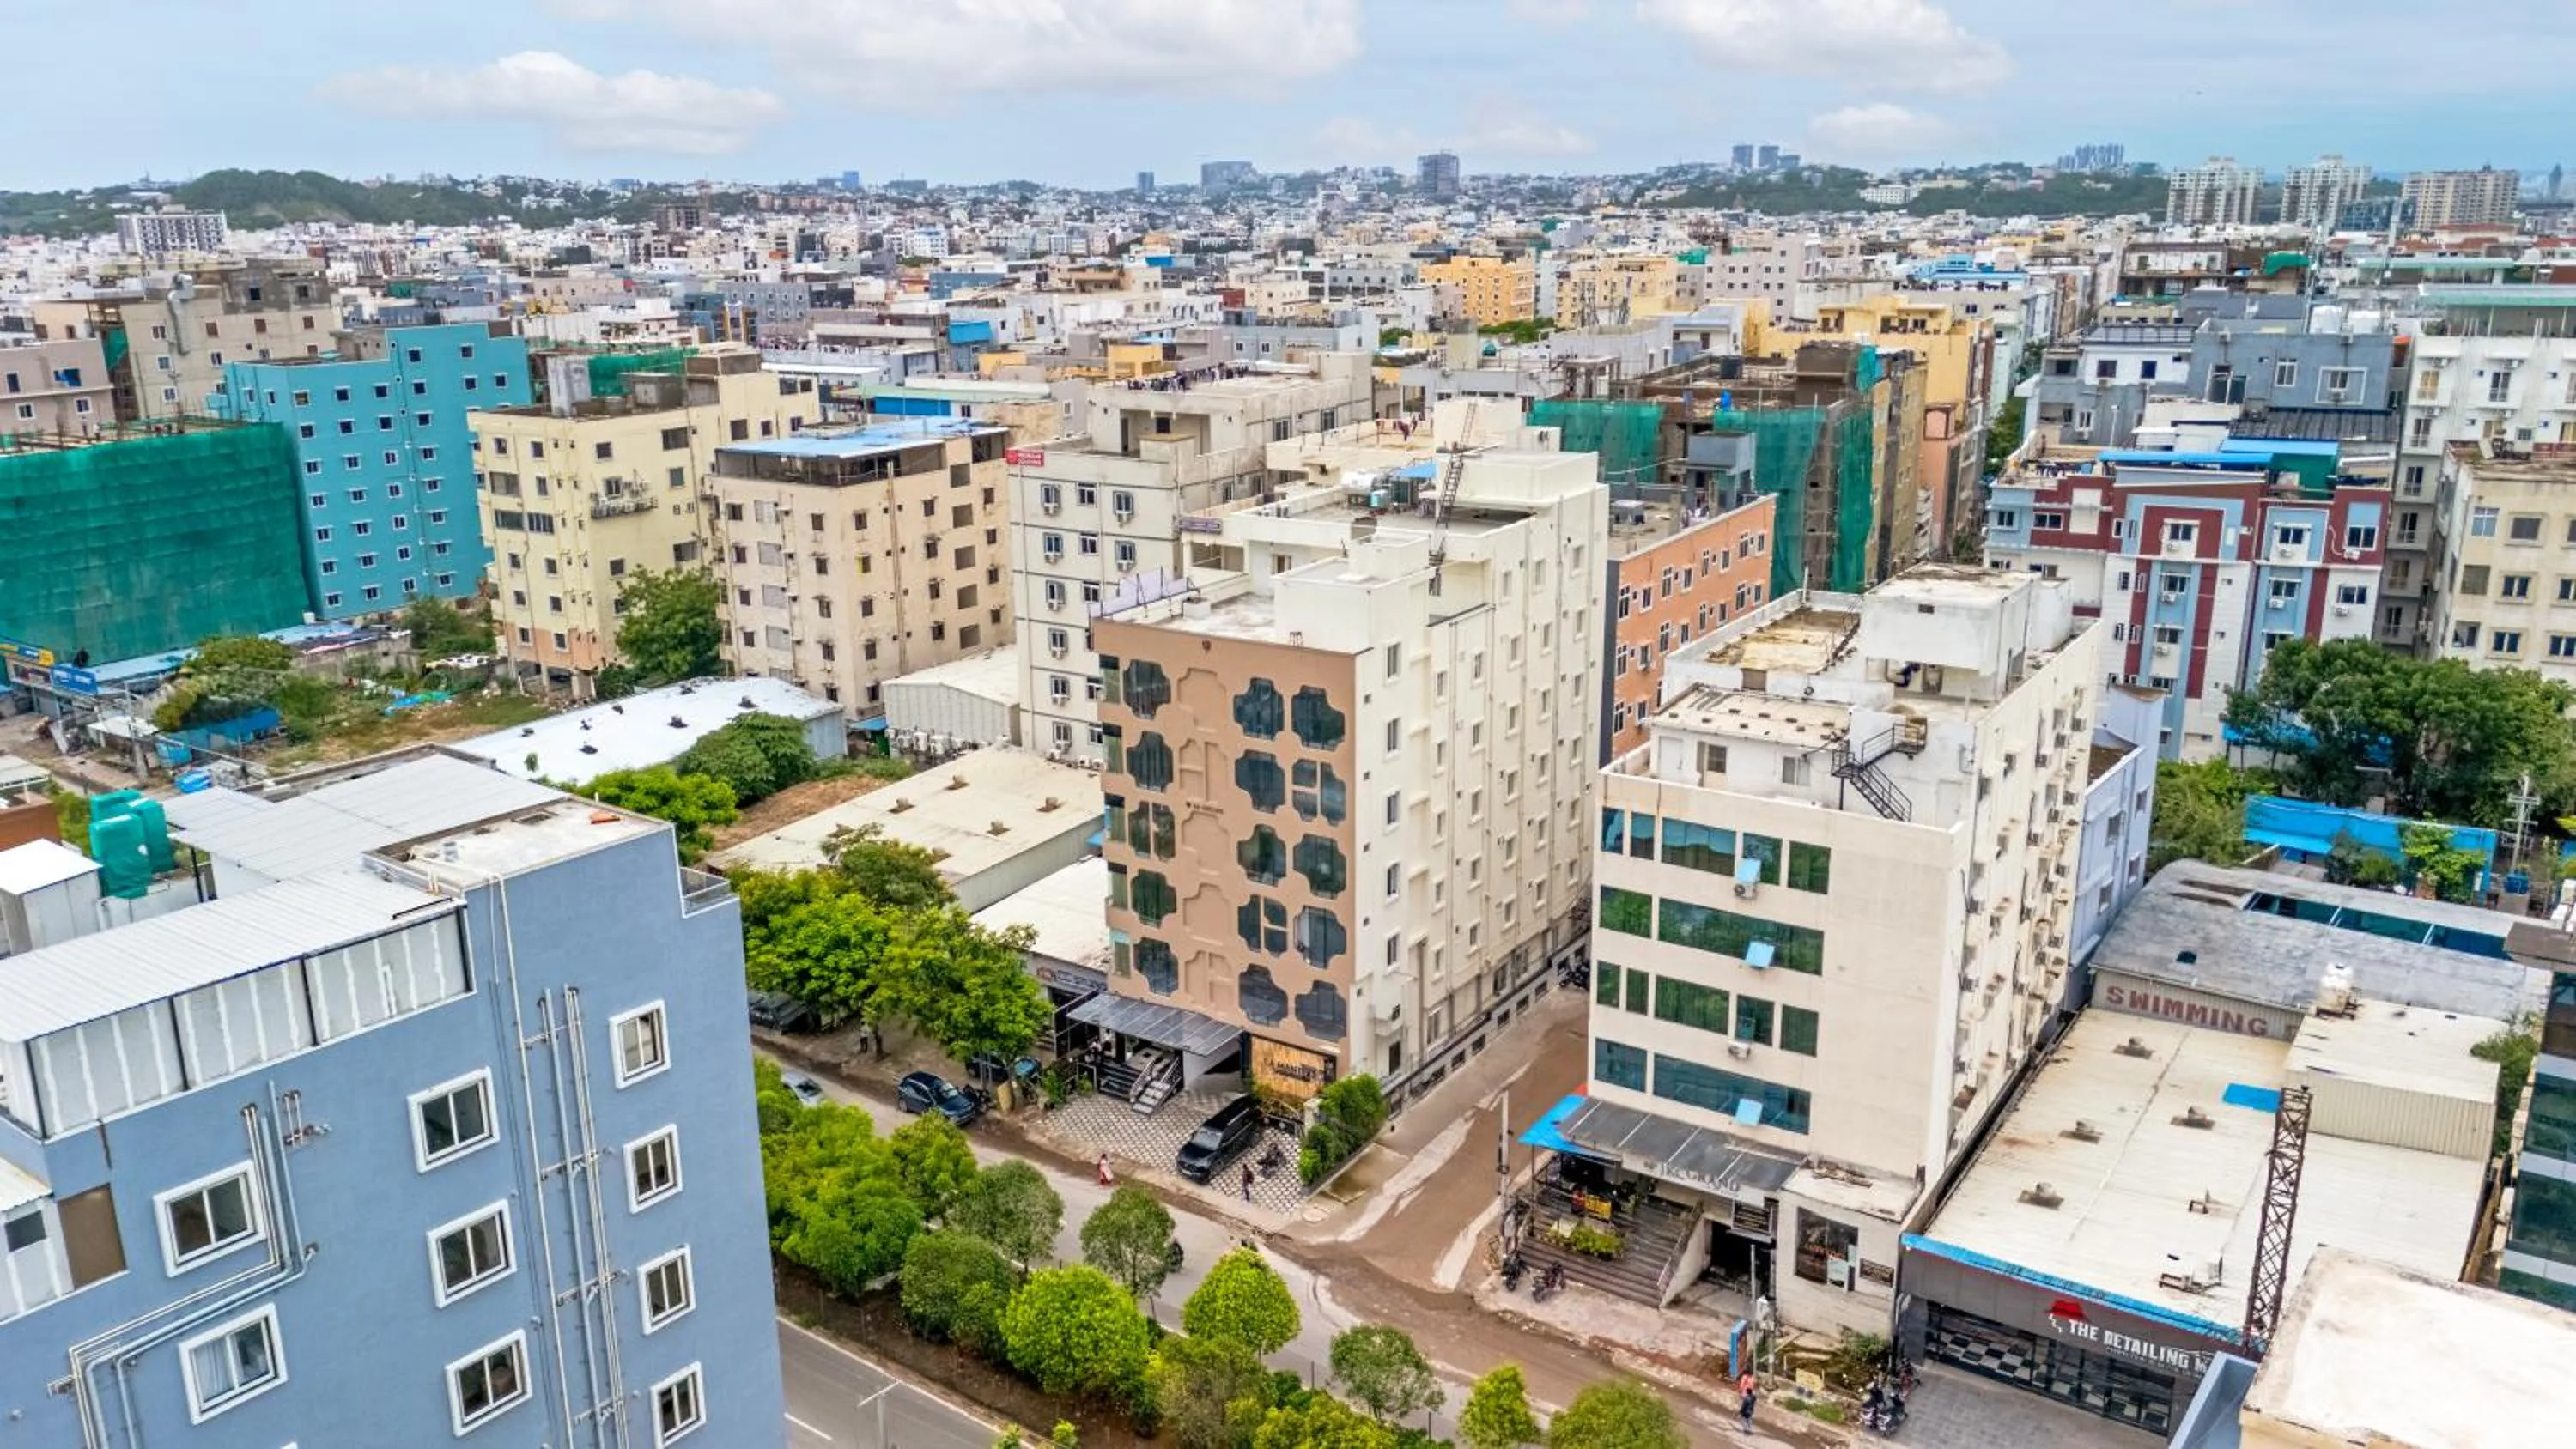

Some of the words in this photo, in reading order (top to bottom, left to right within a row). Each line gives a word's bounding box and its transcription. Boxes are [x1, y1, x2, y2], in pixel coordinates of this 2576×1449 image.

[2106, 985, 2269, 1037] SWIMMING
[2069, 1318, 2099, 1341] THE
[2103, 1330, 2189, 1369] DETAILING
